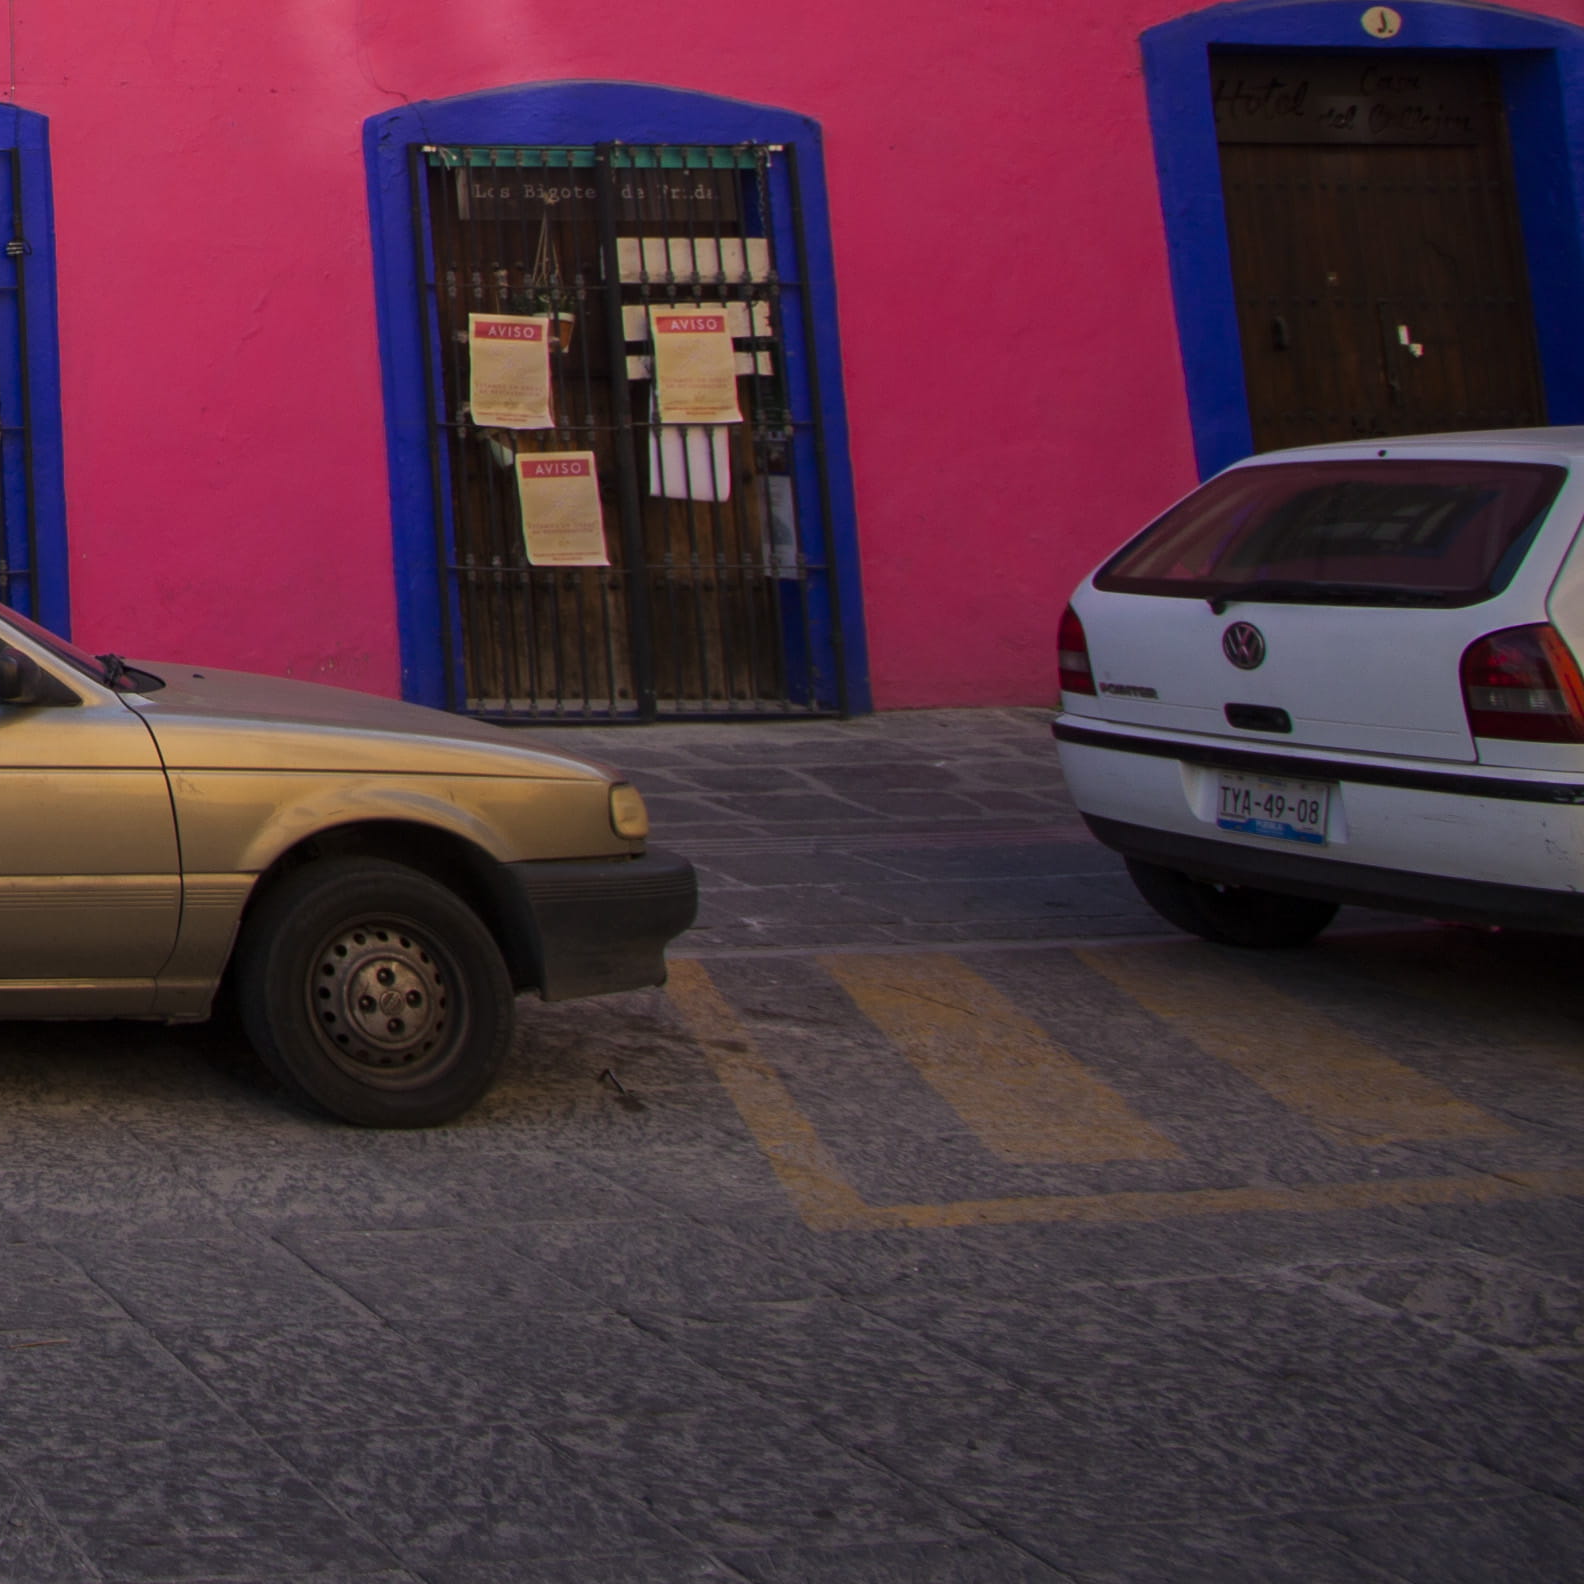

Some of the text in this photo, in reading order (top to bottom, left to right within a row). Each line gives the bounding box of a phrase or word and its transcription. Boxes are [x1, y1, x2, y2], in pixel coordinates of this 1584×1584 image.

[524, 183, 598, 203] Bigote
[670, 318, 718, 331] AVISO
[487, 325, 535, 339] AVISO
[534, 461, 582, 475] AVISO
[1220, 785, 1319, 825] TYA-49-08
